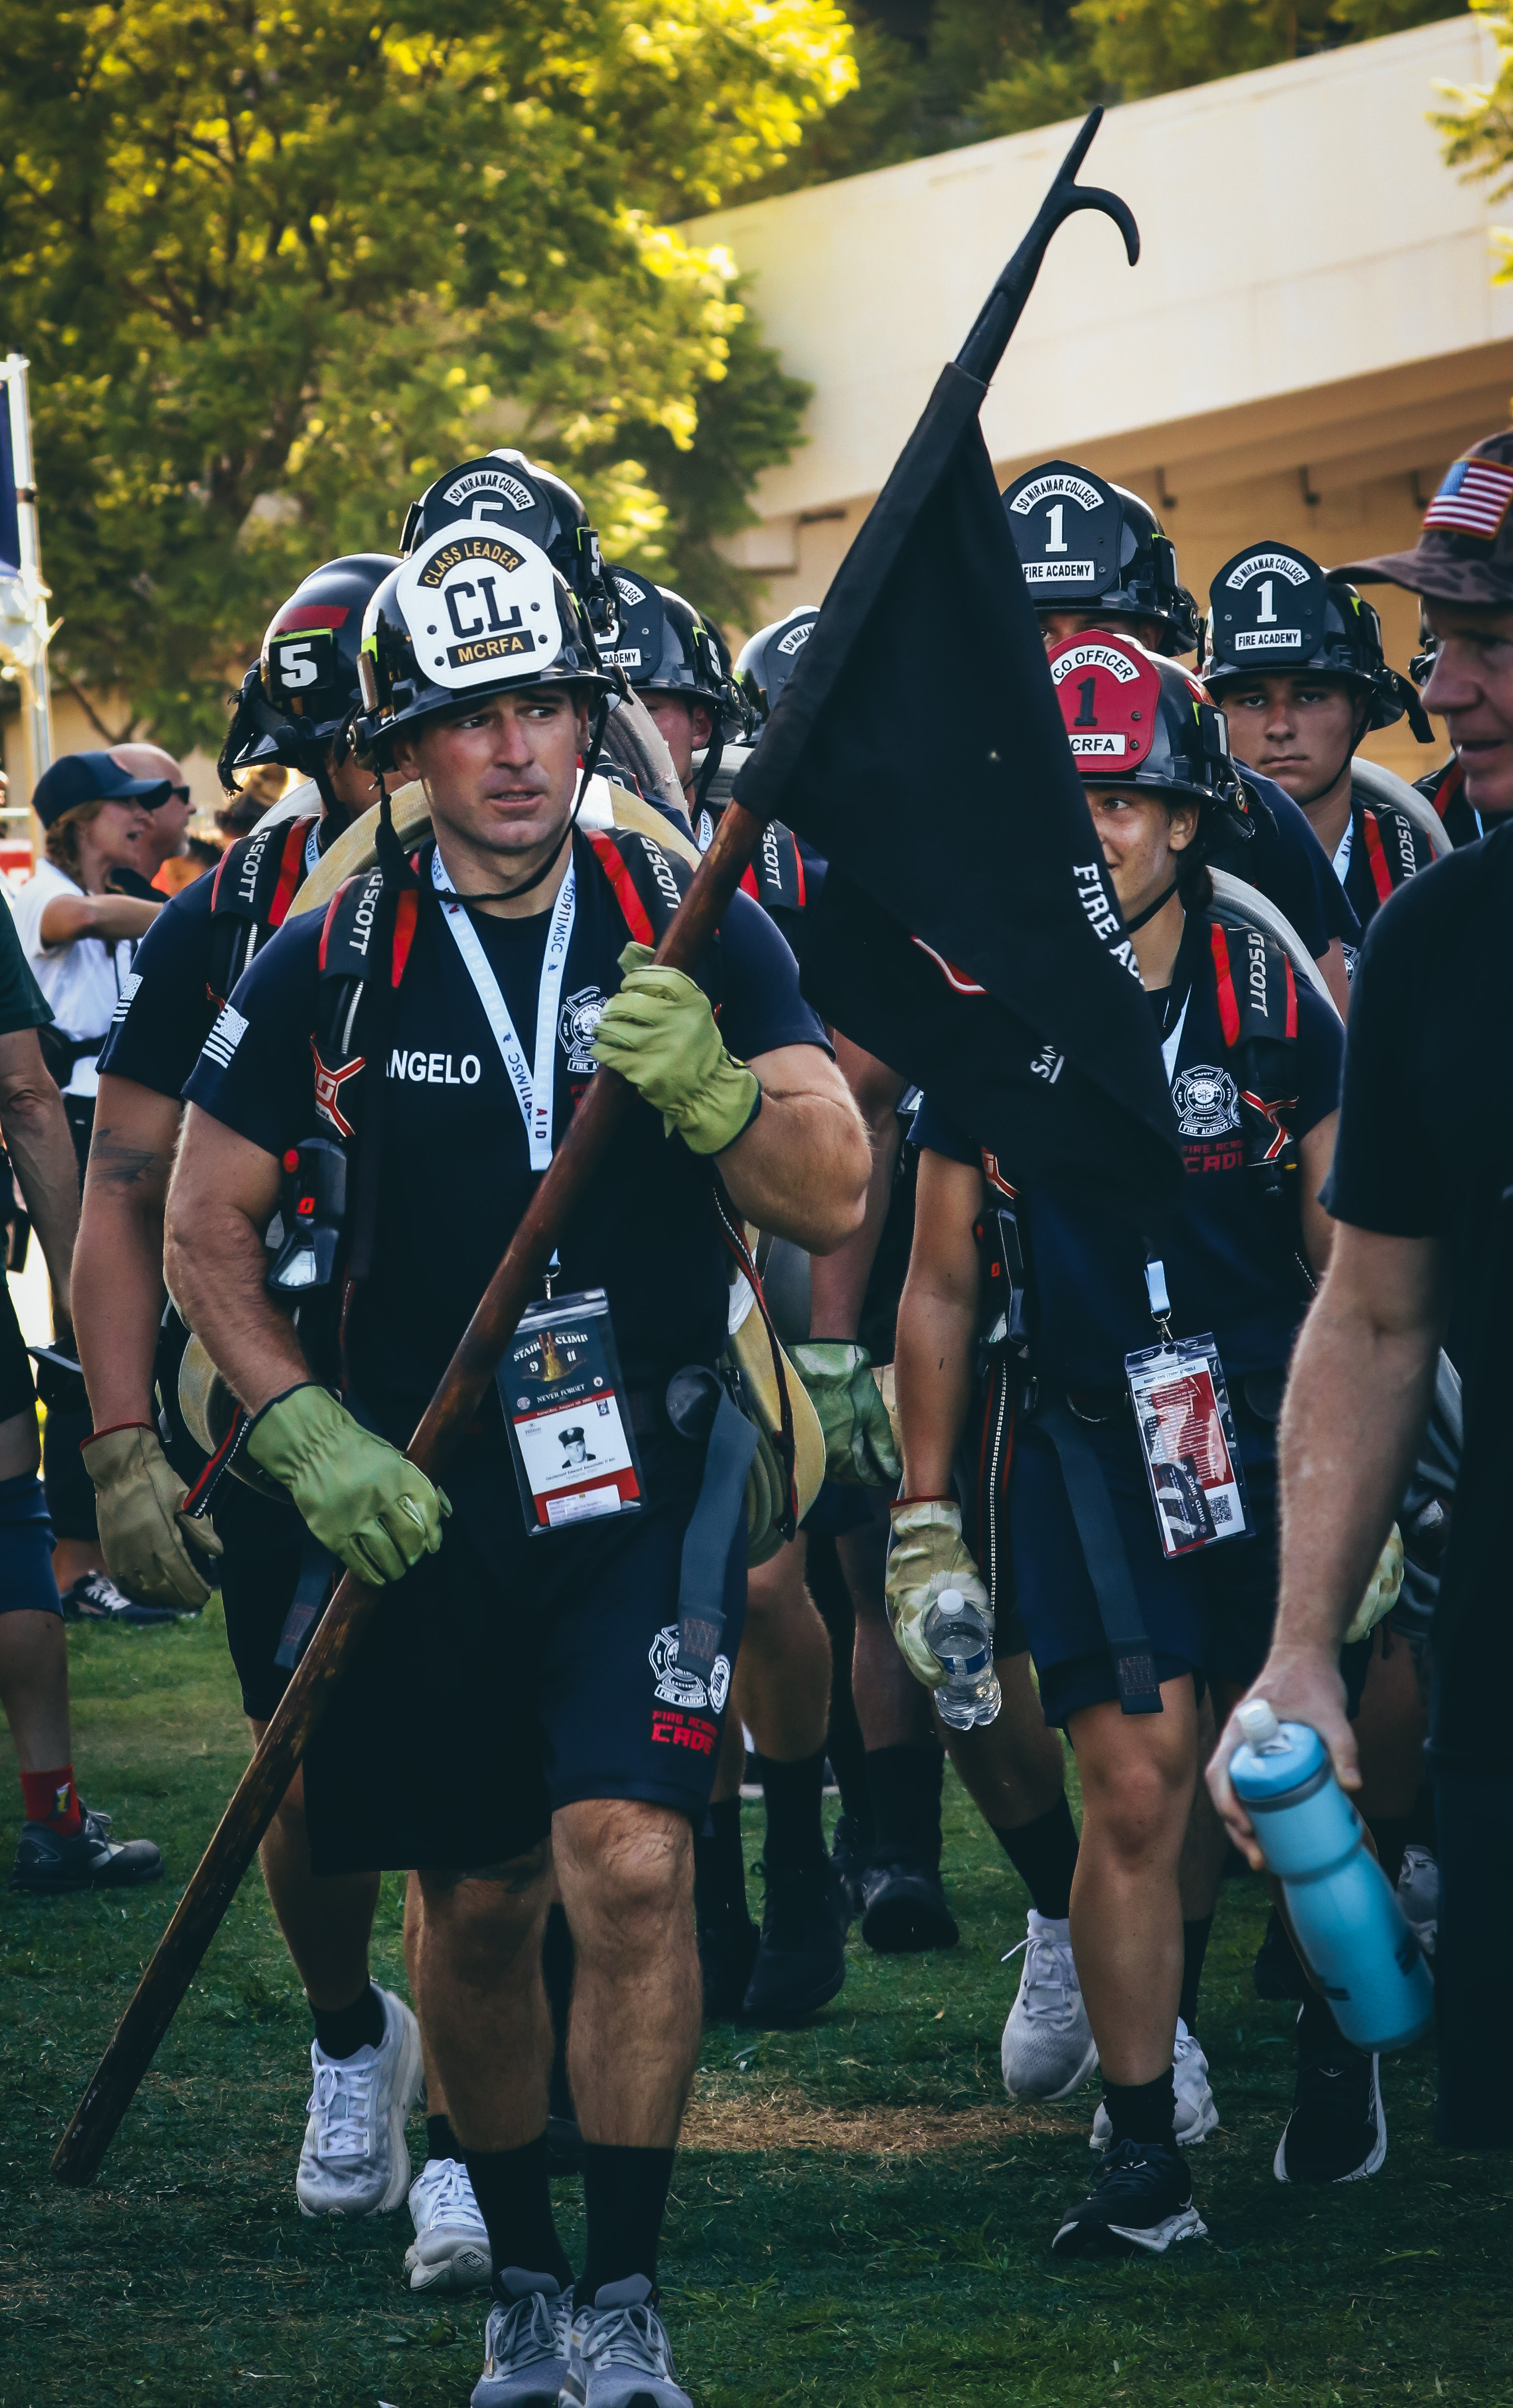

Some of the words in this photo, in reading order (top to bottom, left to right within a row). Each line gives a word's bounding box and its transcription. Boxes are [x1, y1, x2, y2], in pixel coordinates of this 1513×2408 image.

[449, 488, 462, 502] SD
[459, 474, 498, 494] MIRAMAR
[499, 477, 531, 508] COLLEGE
[1016, 498, 1030, 510] SD
[1025, 479, 1064, 502] MIRAMAR
[1065, 480, 1099, 508] COLLEGE
[1045, 504, 1068, 553] 1
[424, 546, 462, 586] CLASS
[464, 541, 519, 571] LEADER
[1024, 566, 1043, 578] FIRE
[1046, 564, 1090, 577] ACADEMY
[1231, 575, 1244, 587] SD
[1239, 557, 1274, 579] MIRAMAR
[1275, 558, 1306, 584] COLLEGE
[444, 576, 523, 639] CL
[1257, 580, 1277, 623] 1
[457, 636, 524, 664] MCRFA
[783, 641, 794, 651] SD
[1238, 635, 1256, 647] FIRE
[1258, 632, 1298, 644] ACADEMY
[280, 642, 318, 688] 5
[1053, 660, 1072, 678] CO
[1075, 650, 1134, 680] OFFICER
[1074, 676, 1098, 726] 1
[1070, 738, 1115, 751] CRFA
[1073, 862, 1120, 940] FIRE
[1109, 940, 1145, 986] AC
[386, 1049, 480, 1084] NGELO
[572, 1062, 589, 1071] FIRE
[1191, 1081, 1218, 1090] MIRAMAR
[535, 1108, 548, 1139] AID
[1182, 1125, 1198, 1134] FIRE
[1201, 1121, 1229, 1135] ACADEMY
[514, 1341, 541, 1362] STAIR
[555, 1334, 589, 1345] CLIMB
[529, 1361, 539, 1372] 9
[536, 1392, 559, 1403] NEVER
[651, 1723, 715, 1755] CADE
